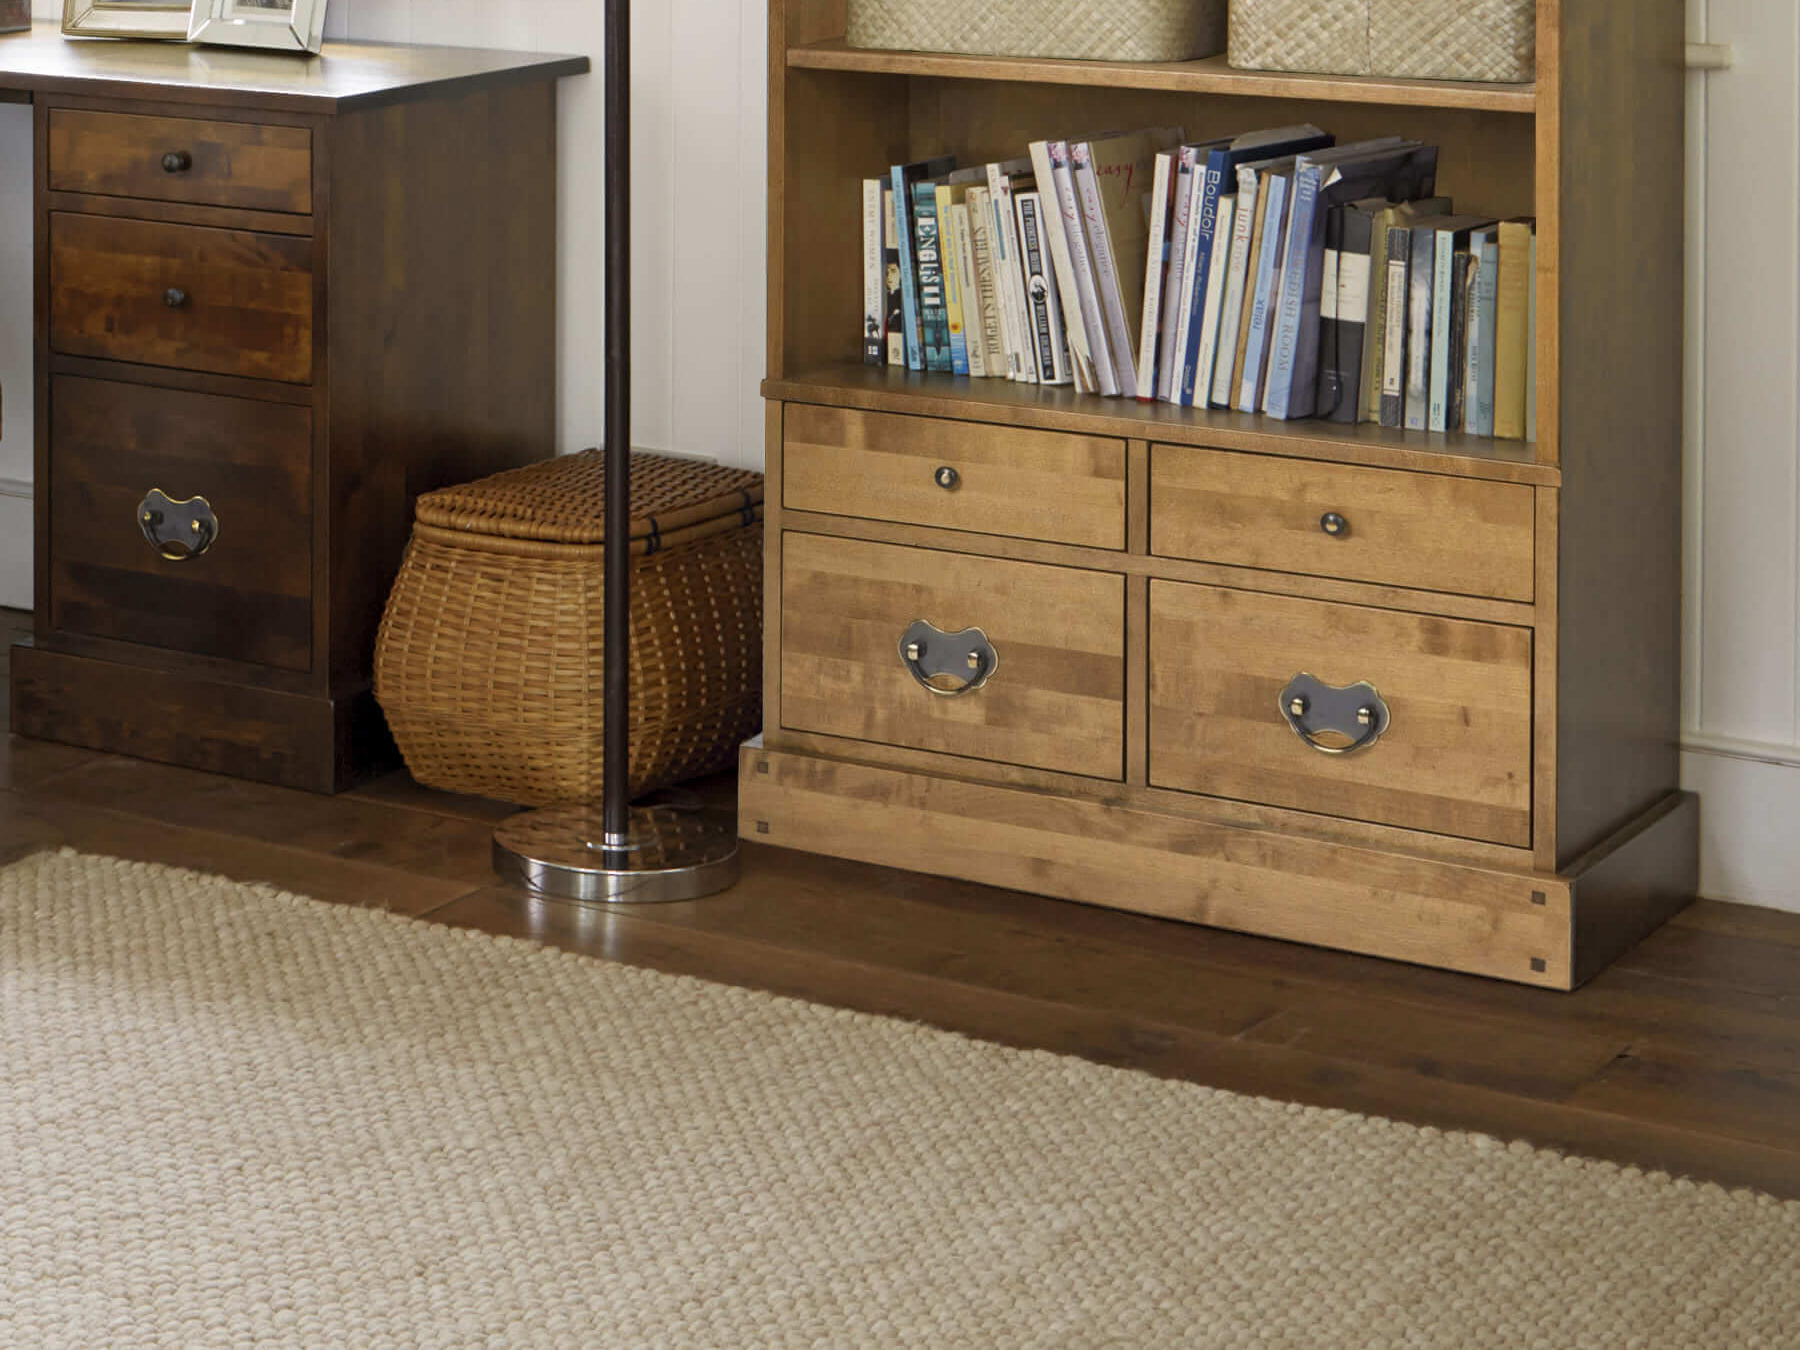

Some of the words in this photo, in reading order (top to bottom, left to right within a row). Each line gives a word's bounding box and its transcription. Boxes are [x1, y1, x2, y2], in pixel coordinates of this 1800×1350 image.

[1064, 187, 1077, 221] easy
[1096, 162, 1133, 210] easy
[1199, 168, 1221, 240] Boudoir
[1083, 187, 1096, 222] easy
[1093, 224, 1110, 277] elegance
[1235, 206, 1250, 242] junk
[973, 225, 993, 302] THESAURUS
[1283, 249, 1304, 319] SWEDISH
[1251, 298, 1265, 331] relax
[1277, 323, 1293, 372] ROOM
